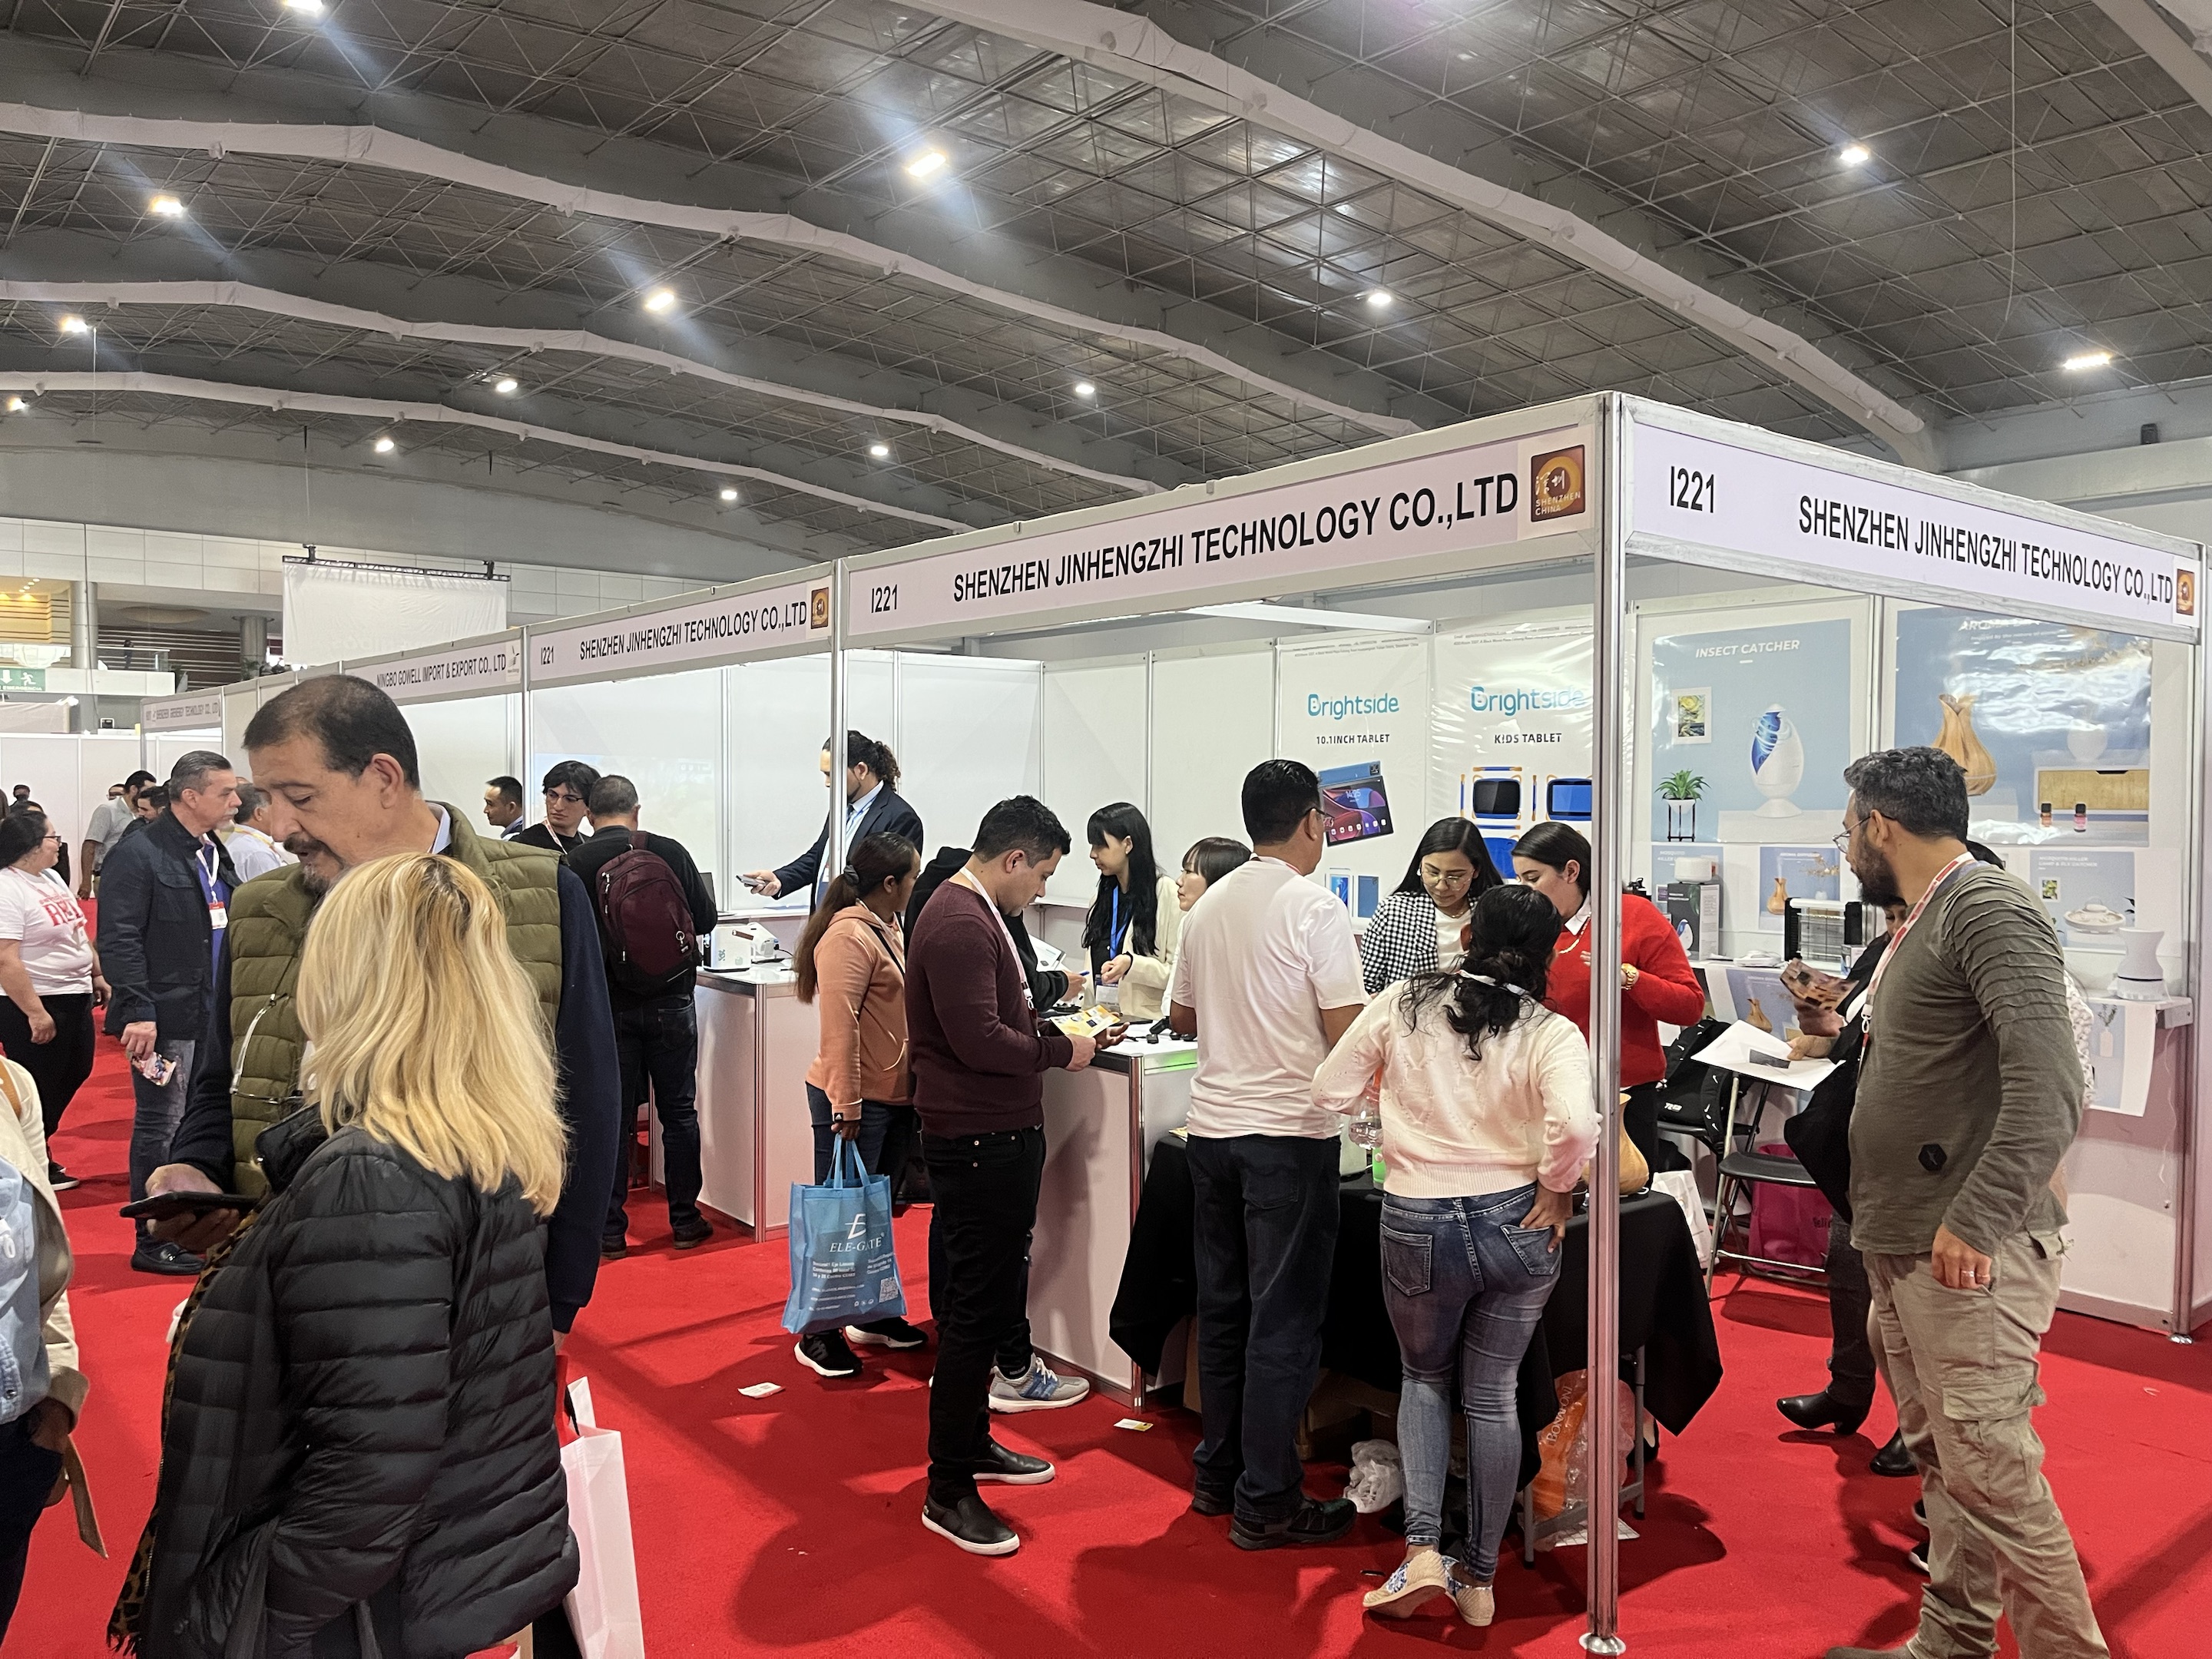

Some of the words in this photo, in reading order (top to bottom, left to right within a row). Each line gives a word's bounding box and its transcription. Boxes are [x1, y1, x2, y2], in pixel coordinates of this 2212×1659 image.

[1535, 491, 1581, 508] SHENZHEN
[1535, 505, 1561, 516] CHINA
[953, 558, 1050, 602] SHENZHEN
[1055, 534, 1184, 586] JINHENGZHI
[1191, 496, 1381, 564] TECHNOLOGY
[1389, 472, 1518, 531] CO.,LTD
[1799, 495, 1909, 551] SHENZHEN
[1915, 521, 2017, 573] JINHENGZHI
[2022, 543, 2121, 594] TECHNOLOGY
[2124, 567, 2173, 605] CO.,LTD
[580, 634, 624, 661] SHENZHEN
[626, 625, 681, 652] JINHENGZHI
[684, 611, 757, 643] TECHNOLOGY
[761, 601, 807, 633] CO.,LTD
[1695, 645, 1739, 658] INSECT
[1740, 640, 1800, 654] CATCHER
[376, 672, 397, 688] NINGBO
[398, 667, 422, 686] GOWELL
[422, 663, 445, 682] IMPORT
[446, 663, 450, 678] &
[452, 658, 478, 678] EXPORT
[478, 657, 492, 675] CO.,
[493, 653, 506, 672] LTD
[1308, 693, 1399, 720] Brightside
[1316, 735, 1355, 745] 10.1INCH
[1356, 733, 1390, 743] TABLET
[1494, 734, 1519, 743] KIDS
[1522, 733, 1561, 743] TABLET
[830, 1237, 882, 1253] ELE-GATE
